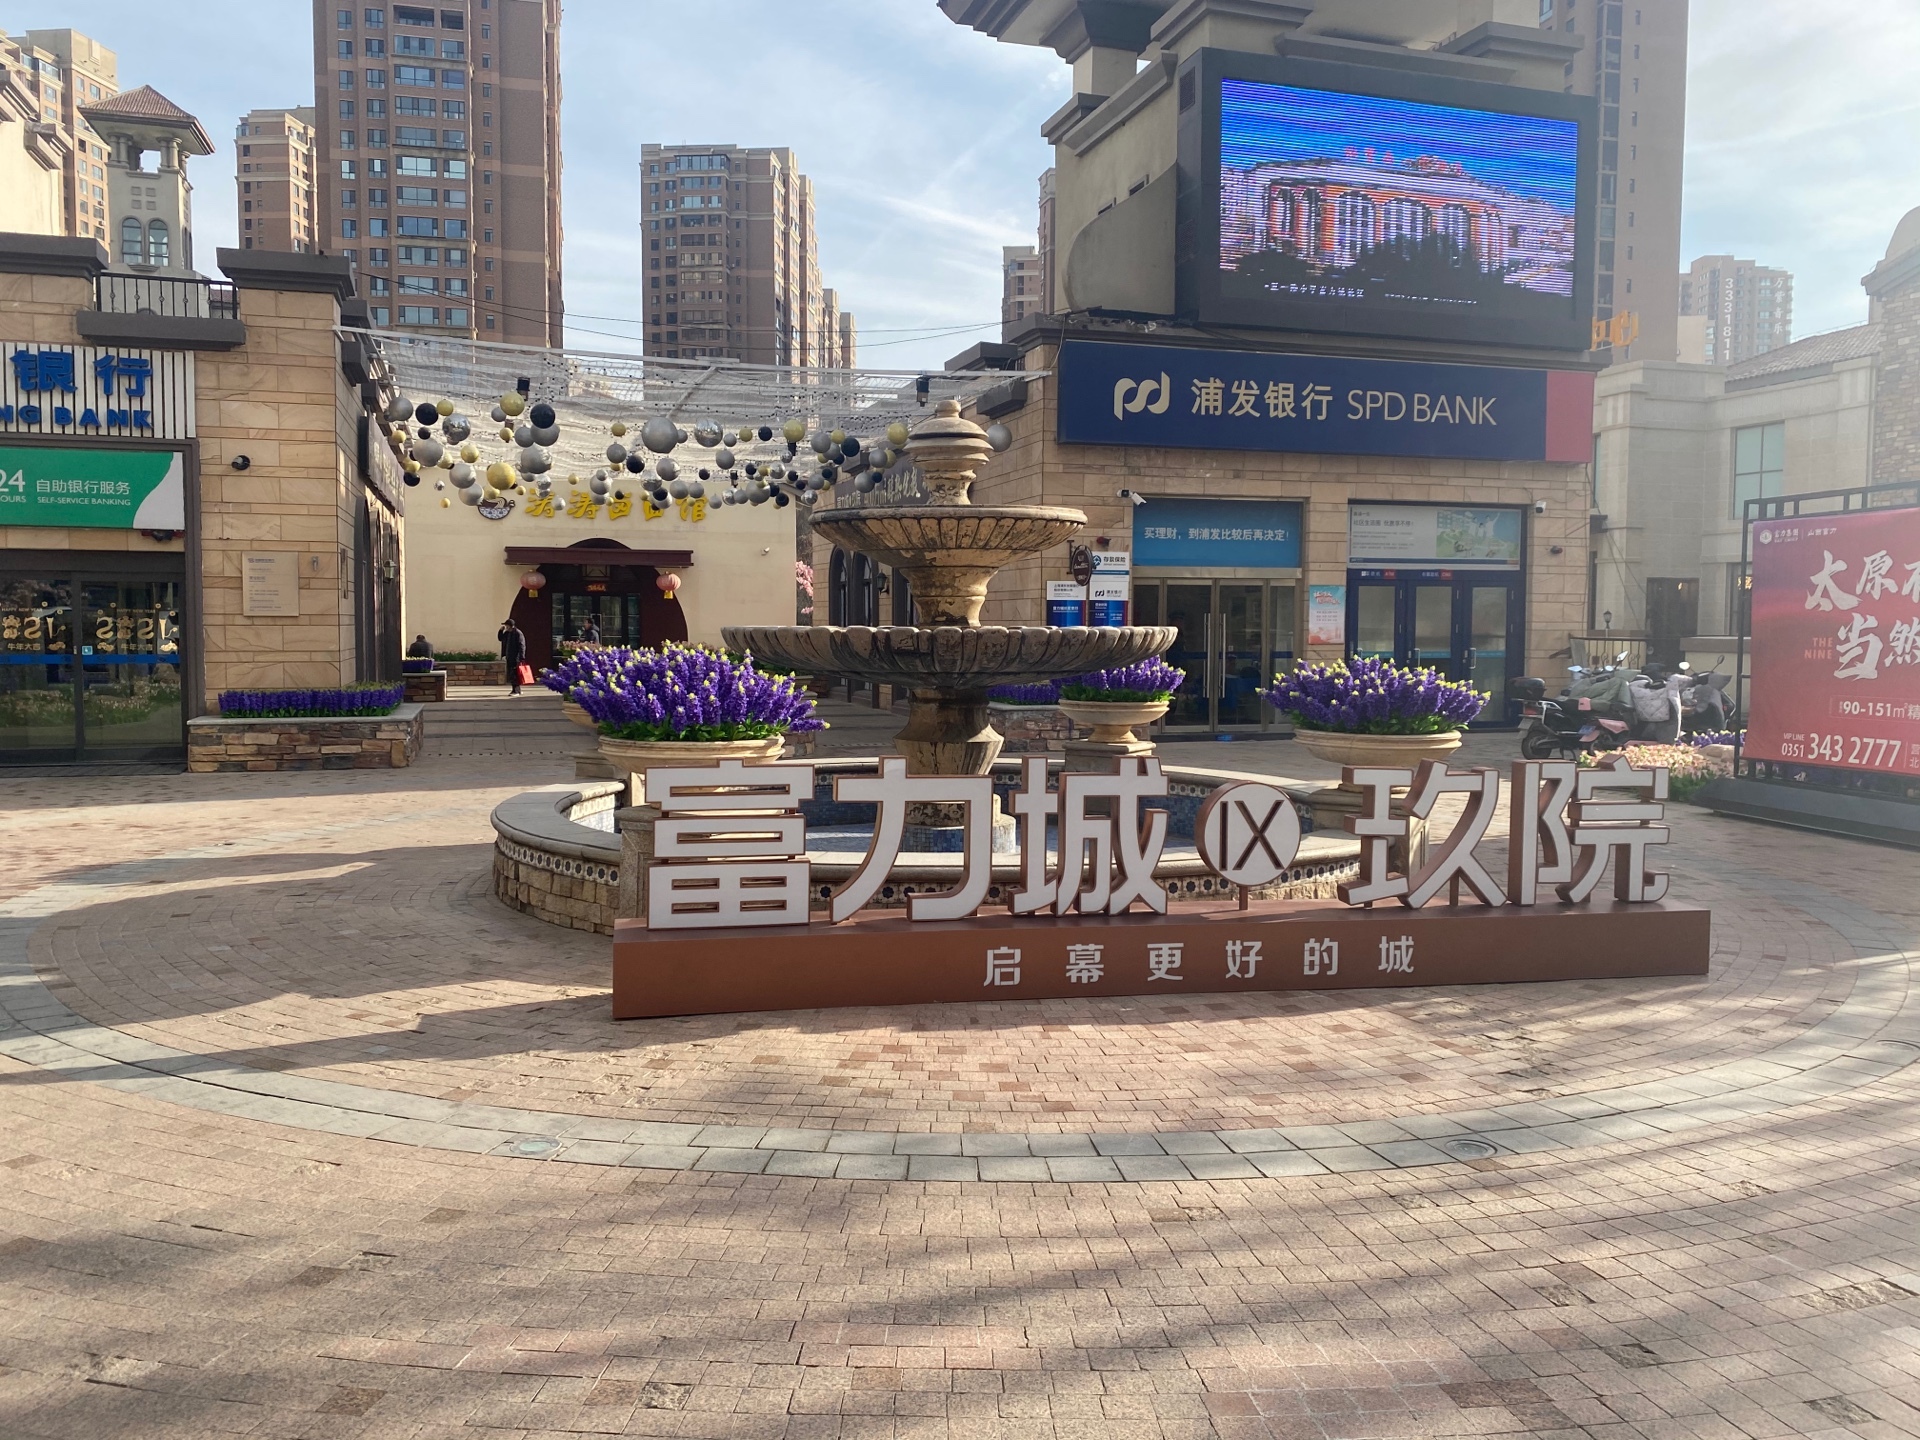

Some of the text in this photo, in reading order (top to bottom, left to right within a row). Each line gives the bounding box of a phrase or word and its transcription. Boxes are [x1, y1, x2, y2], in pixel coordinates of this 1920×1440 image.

[1723, 278, 1733, 360] 3331811
[10, 350, 153, 397] 银行
[54, 407, 153, 428] BANK
[1191, 377, 1497, 425] 浦发银行 SPD BANK
[36, 479, 131, 495] 自助银行服务
[37, 496, 131, 506] SELF-SERVICE BANKING
[8, 643, 41, 651] 牛年大吉
[1804, 649, 1832, 660] NINE
[1813, 637, 1833, 648] THE
[1834, 613, 1920, 681] 当然
[1782, 733, 1901, 768] 0351 343 2777
[645, 757, 1168, 930] 富力城
[1338, 755, 1670, 910] 玖院
[983, 936, 1414, 987] 启幕更好的城
